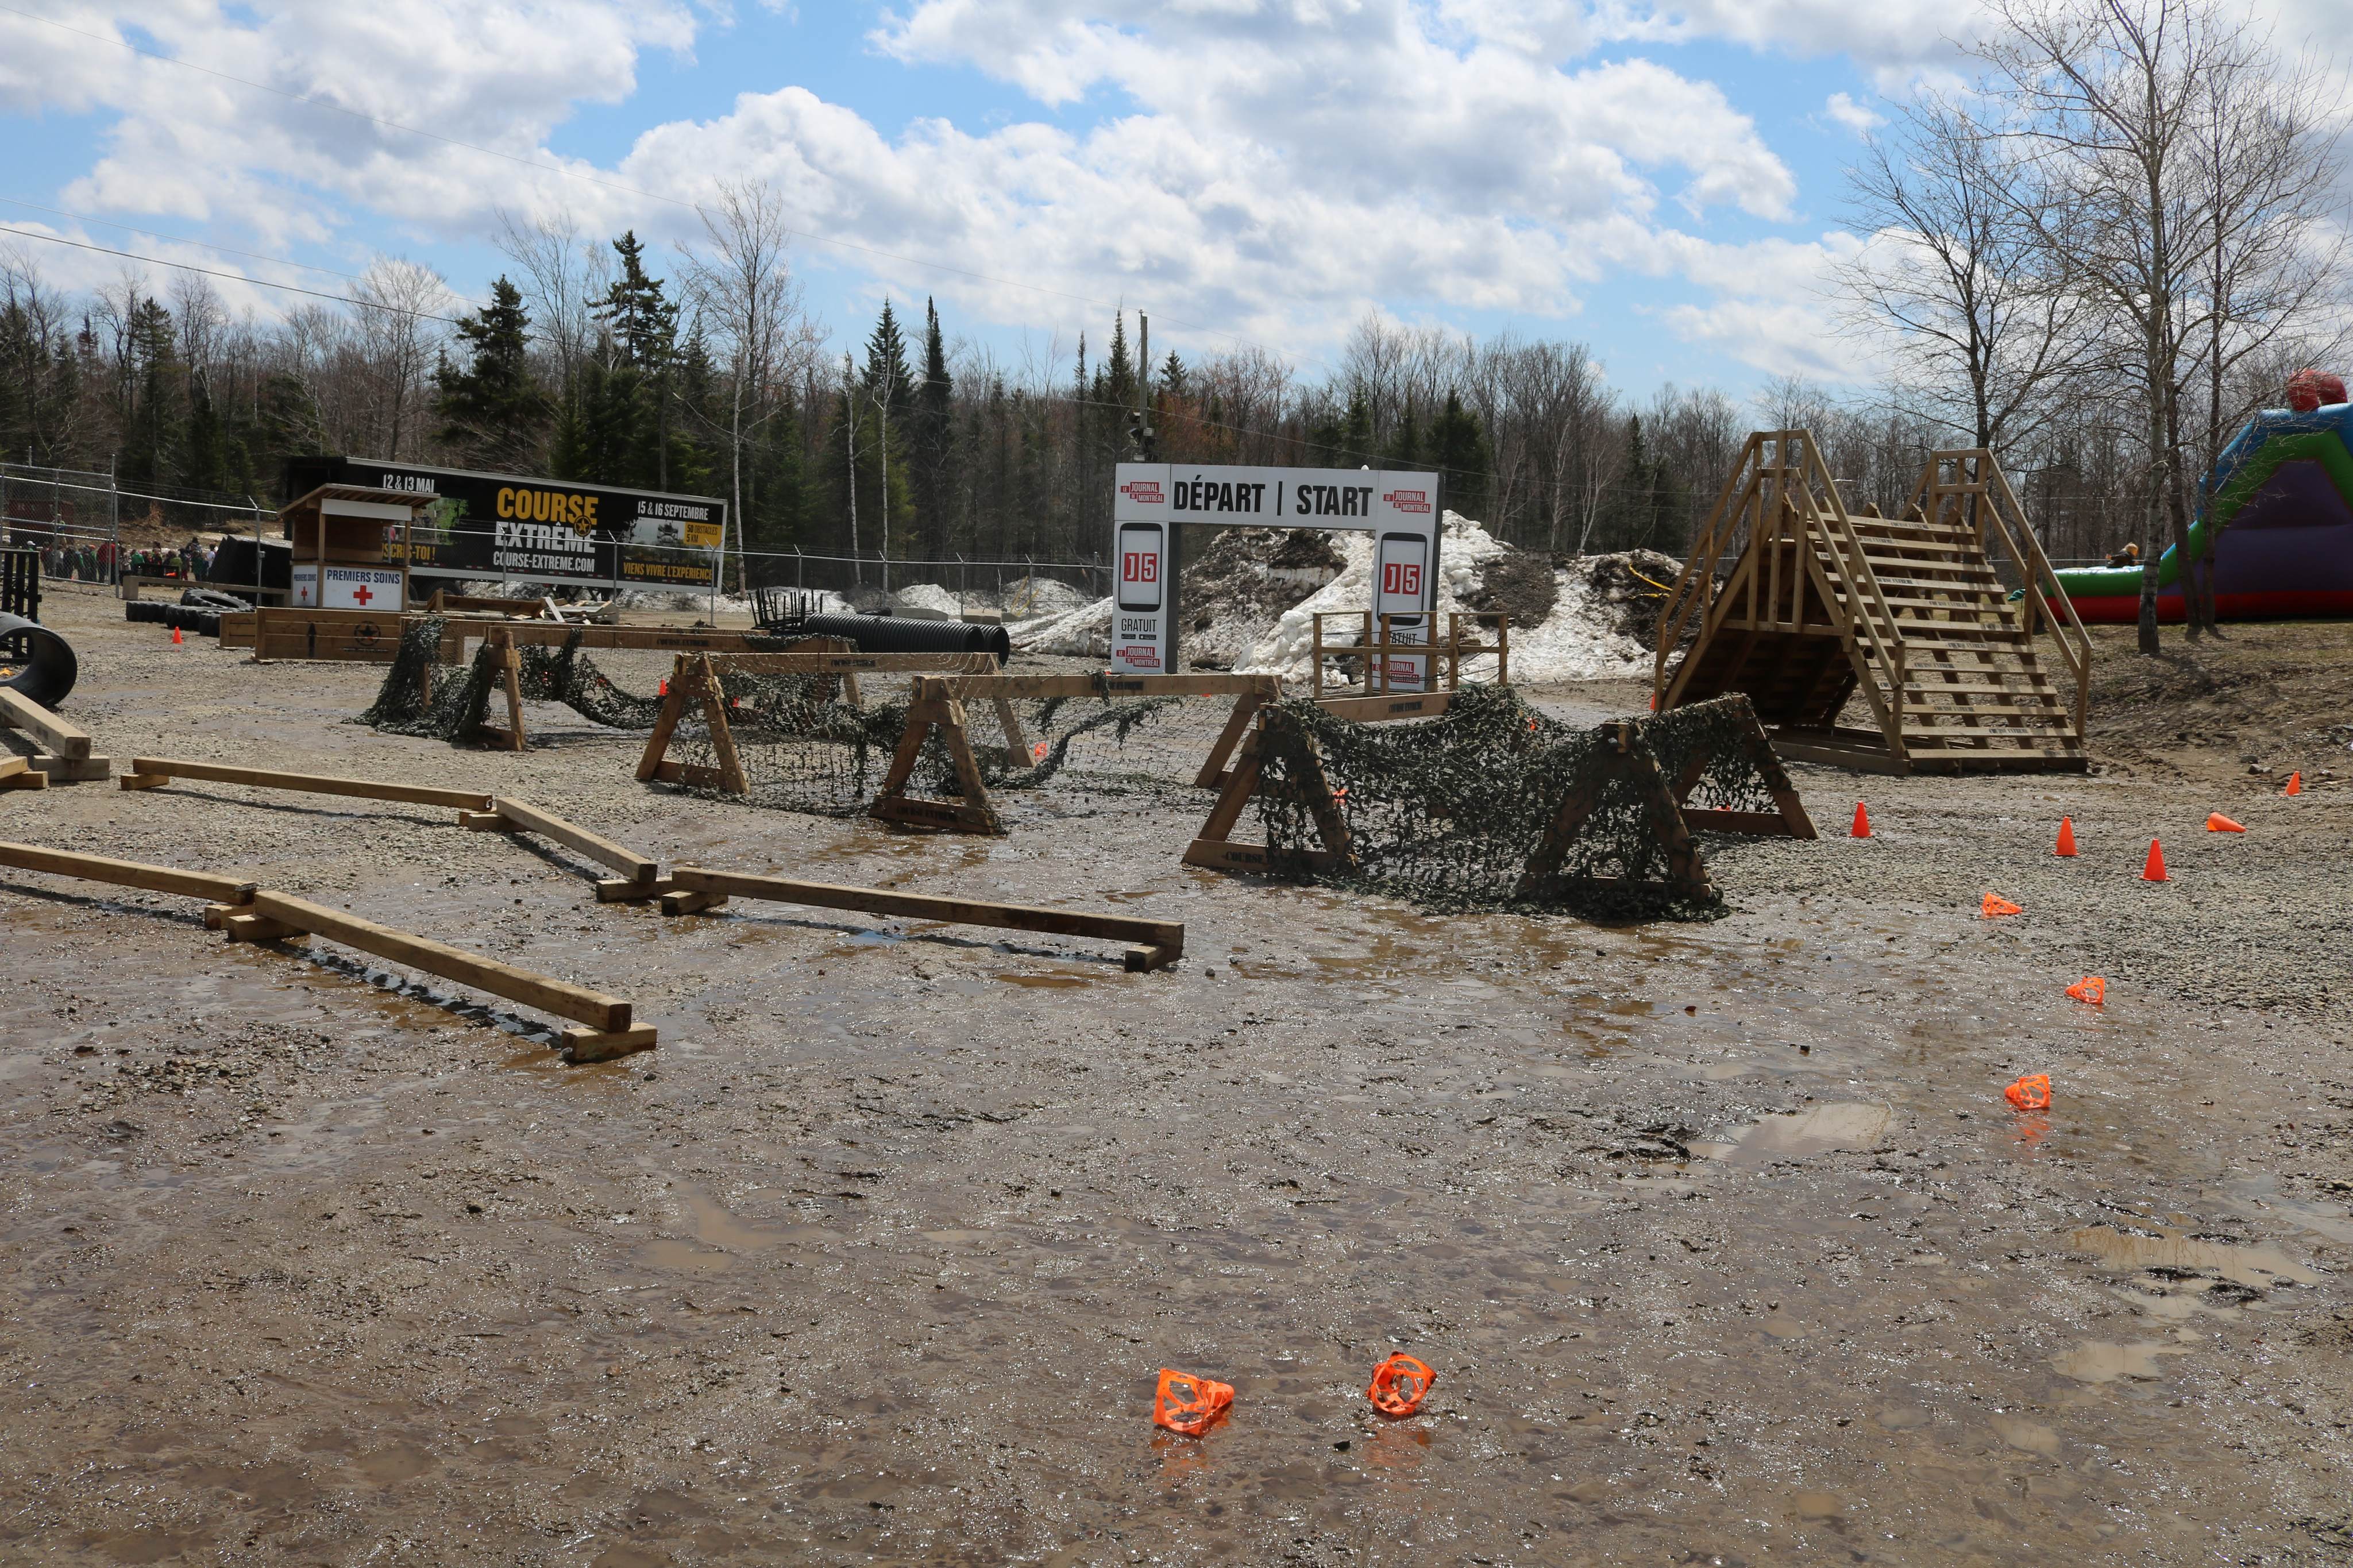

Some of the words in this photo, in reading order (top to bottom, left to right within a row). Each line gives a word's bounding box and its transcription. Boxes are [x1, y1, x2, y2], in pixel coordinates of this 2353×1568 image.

[383, 474, 394, 488] 12
[395, 476, 402, 490] &
[404, 477, 414, 491] 13
[416, 478, 434, 493] MAI
[1131, 483, 1158, 492] JOURNAL
[1138, 494, 1163, 502] MONTRÉAL
[1174, 474, 1266, 512] DÉPART
[1394, 491, 1424, 501] JOURNAL
[497, 487, 599, 525] COURSE
[1297, 485, 1374, 516] START
[638, 501, 646, 514] 15
[647, 502, 653, 515] &
[655, 503, 663, 516] 16
[664, 504, 709, 520] SEPTEMBRE
[1402, 504, 1430, 512] MONTRÉAL
[687, 524, 694, 533] 50
[695, 525, 718, 535] OBSTACLES
[495, 521, 597, 553] EXTRÊME
[686, 534, 690, 542] 5
[493, 551, 595, 573] COURSE-EXTREME.COM
[623, 562, 645, 575] VIENS
[646, 564, 666, 576] VIVRE
[327, 569, 371, 582] PREMIERS
[373, 572, 400, 584] SOINS
[1121, 618, 1157, 632] GRATUIT
[1379, 632, 1417, 644] ATUIT
[1127, 647, 1154, 657] JOURNAL
[1135, 658, 1159, 667] MONTRÉAL
